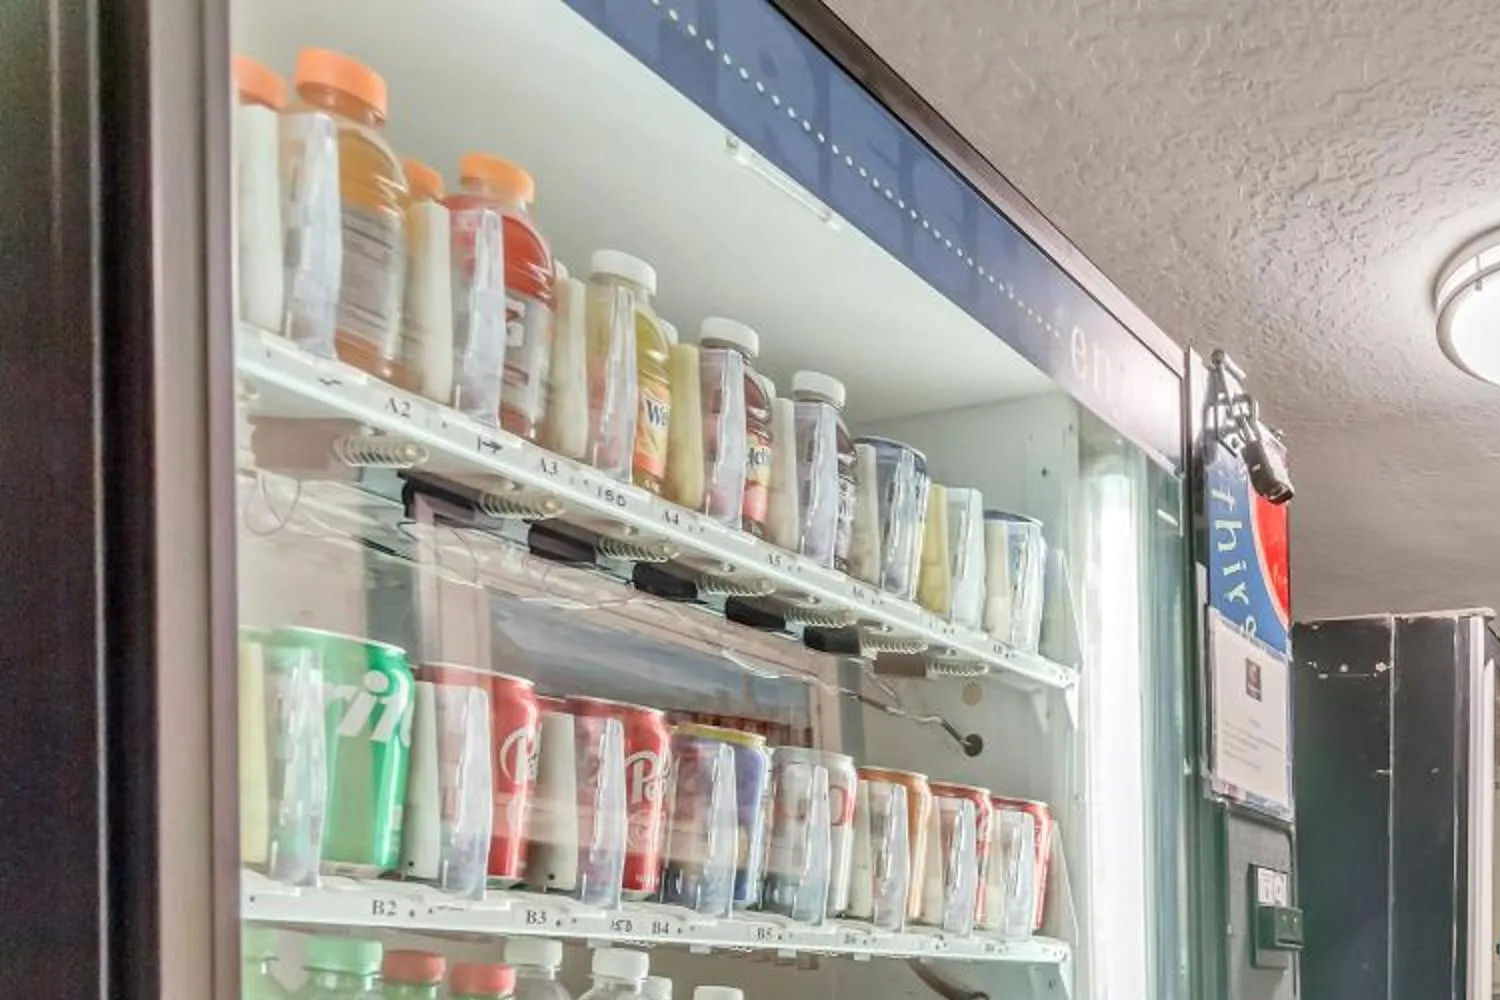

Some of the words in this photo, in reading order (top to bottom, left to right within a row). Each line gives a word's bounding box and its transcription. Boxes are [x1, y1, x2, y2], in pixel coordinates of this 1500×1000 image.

[371, 898, 398, 917] B2
[525, 908, 548, 926] B3
[651, 920, 670, 935] B4
